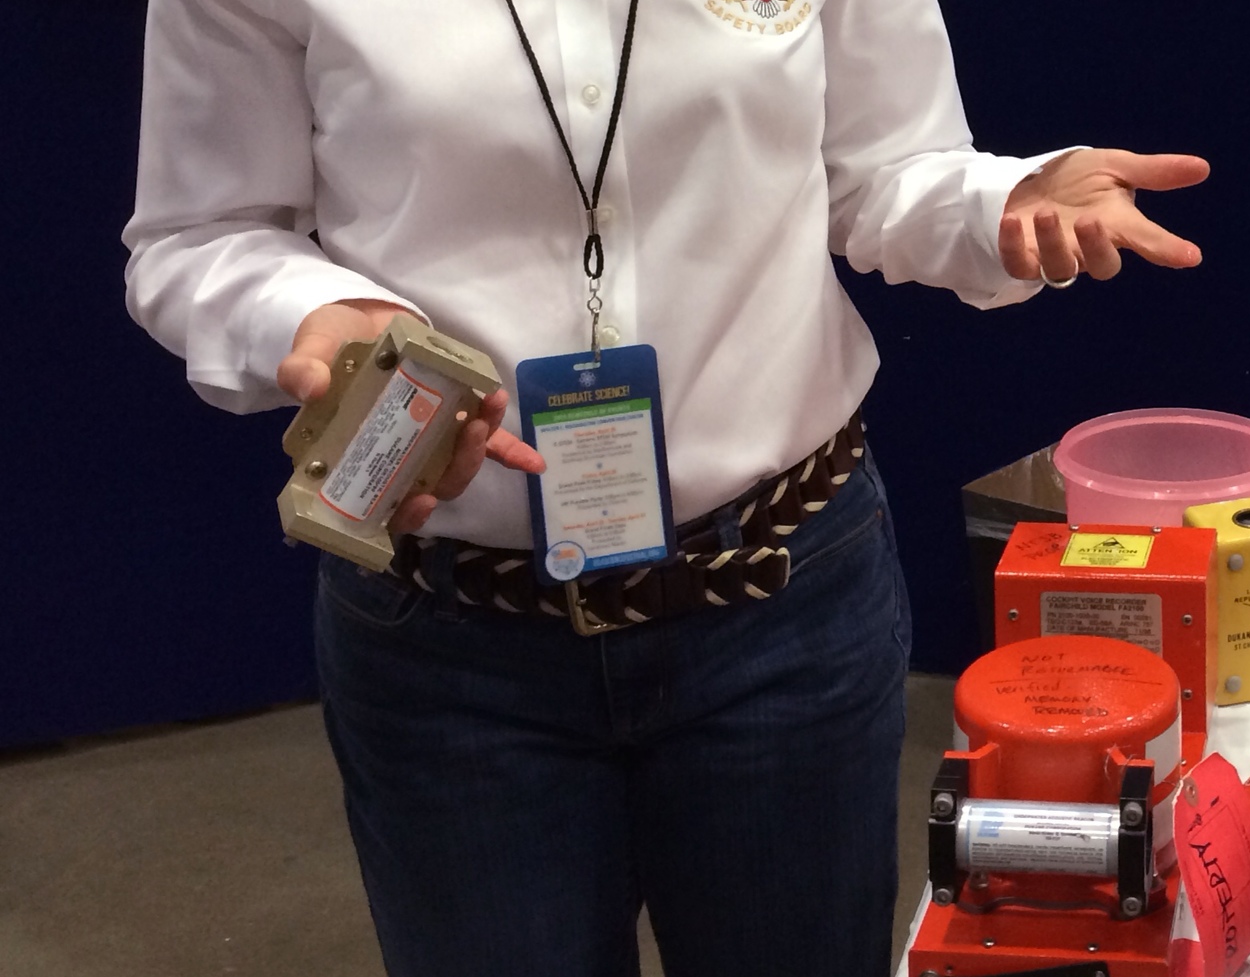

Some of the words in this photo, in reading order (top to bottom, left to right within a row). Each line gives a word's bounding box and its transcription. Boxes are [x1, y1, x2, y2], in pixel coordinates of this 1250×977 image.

[704, 0, 766, 34] SAFETY
[774, 2, 812, 35] BOARD
[548, 390, 593, 407] CELEBRATE
[1078, 547, 1138, 555] ATTENION
